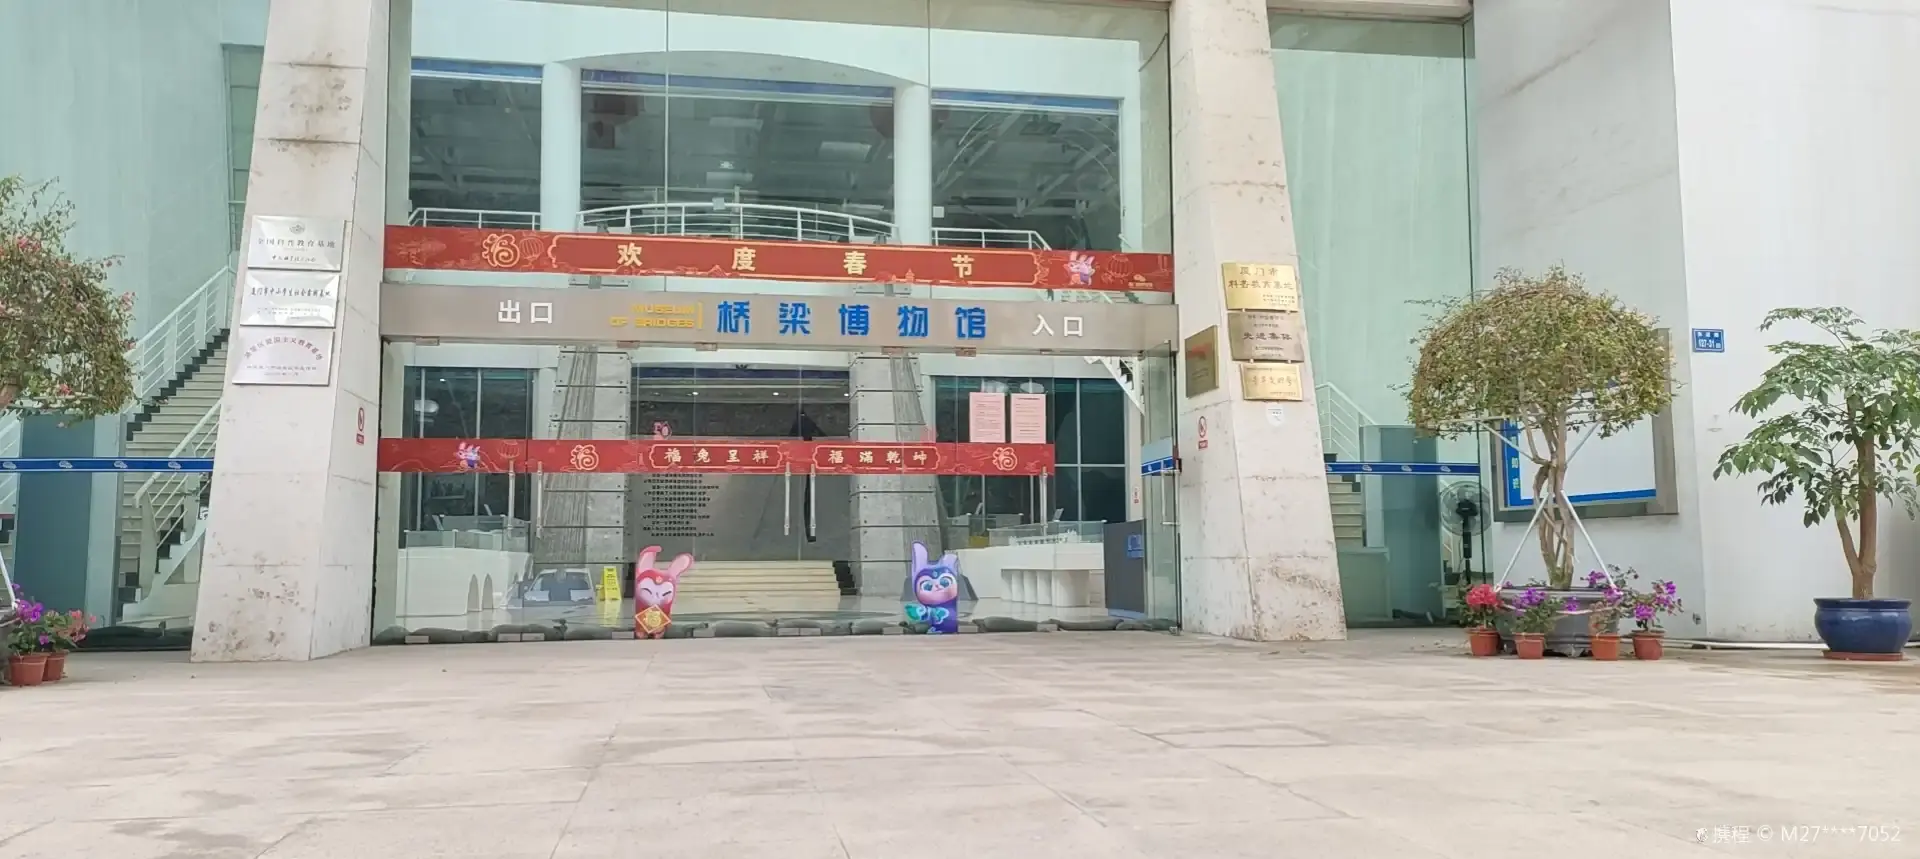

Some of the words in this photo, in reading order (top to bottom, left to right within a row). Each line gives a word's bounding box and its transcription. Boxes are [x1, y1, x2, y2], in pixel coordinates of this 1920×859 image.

[617, 243, 975, 278] 欢度春节
[497, 300, 553, 325] 出口
[716, 300, 987, 339] 桥梁博物馆
[1032, 313, 1085, 338] 入口
[664, 447, 769, 465] 福兔呈祥
[828, 449, 929, 466] 福满乾坤
